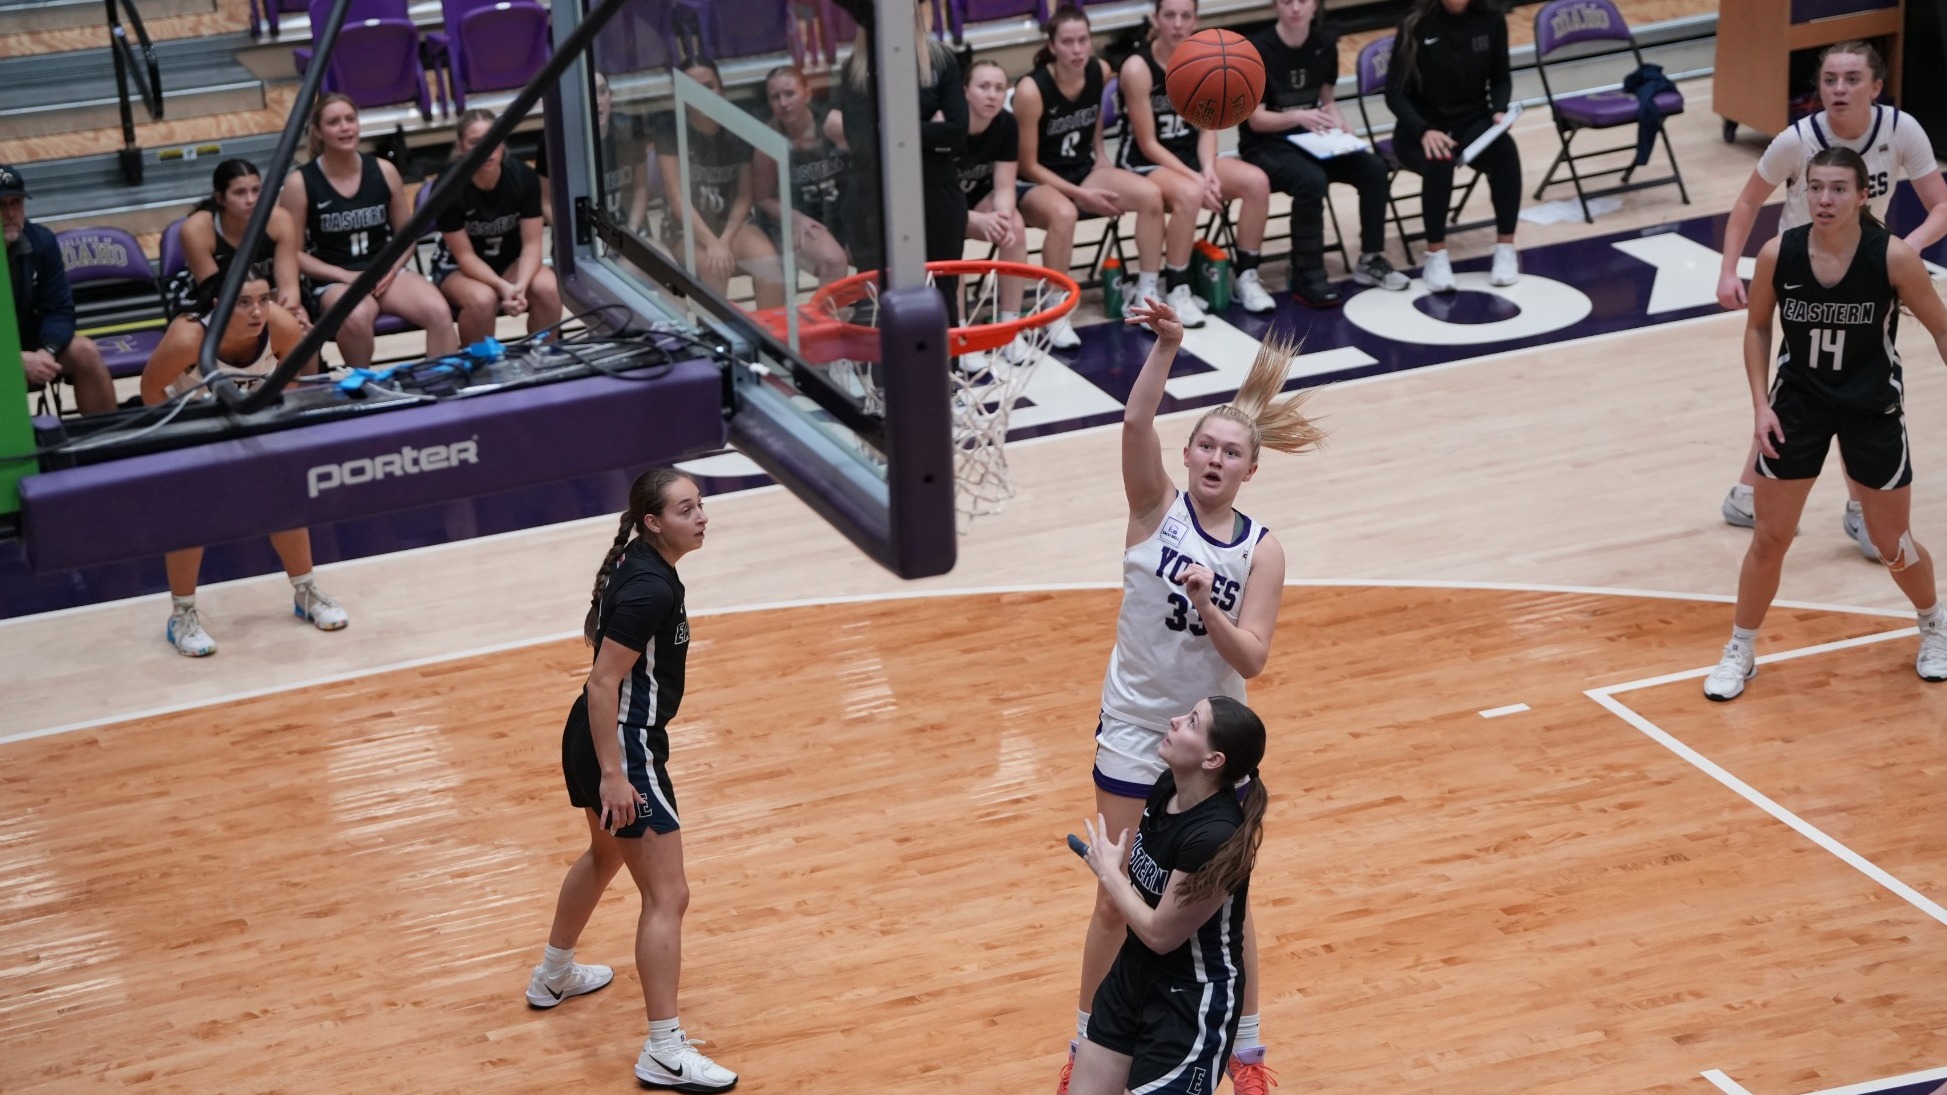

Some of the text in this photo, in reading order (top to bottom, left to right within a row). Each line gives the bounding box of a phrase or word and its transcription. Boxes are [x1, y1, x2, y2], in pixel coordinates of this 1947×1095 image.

[1783, 298, 1875, 324] EASTERN
[1809, 328, 1846, 371] 14
[1156, 545, 1240, 612] YOES
